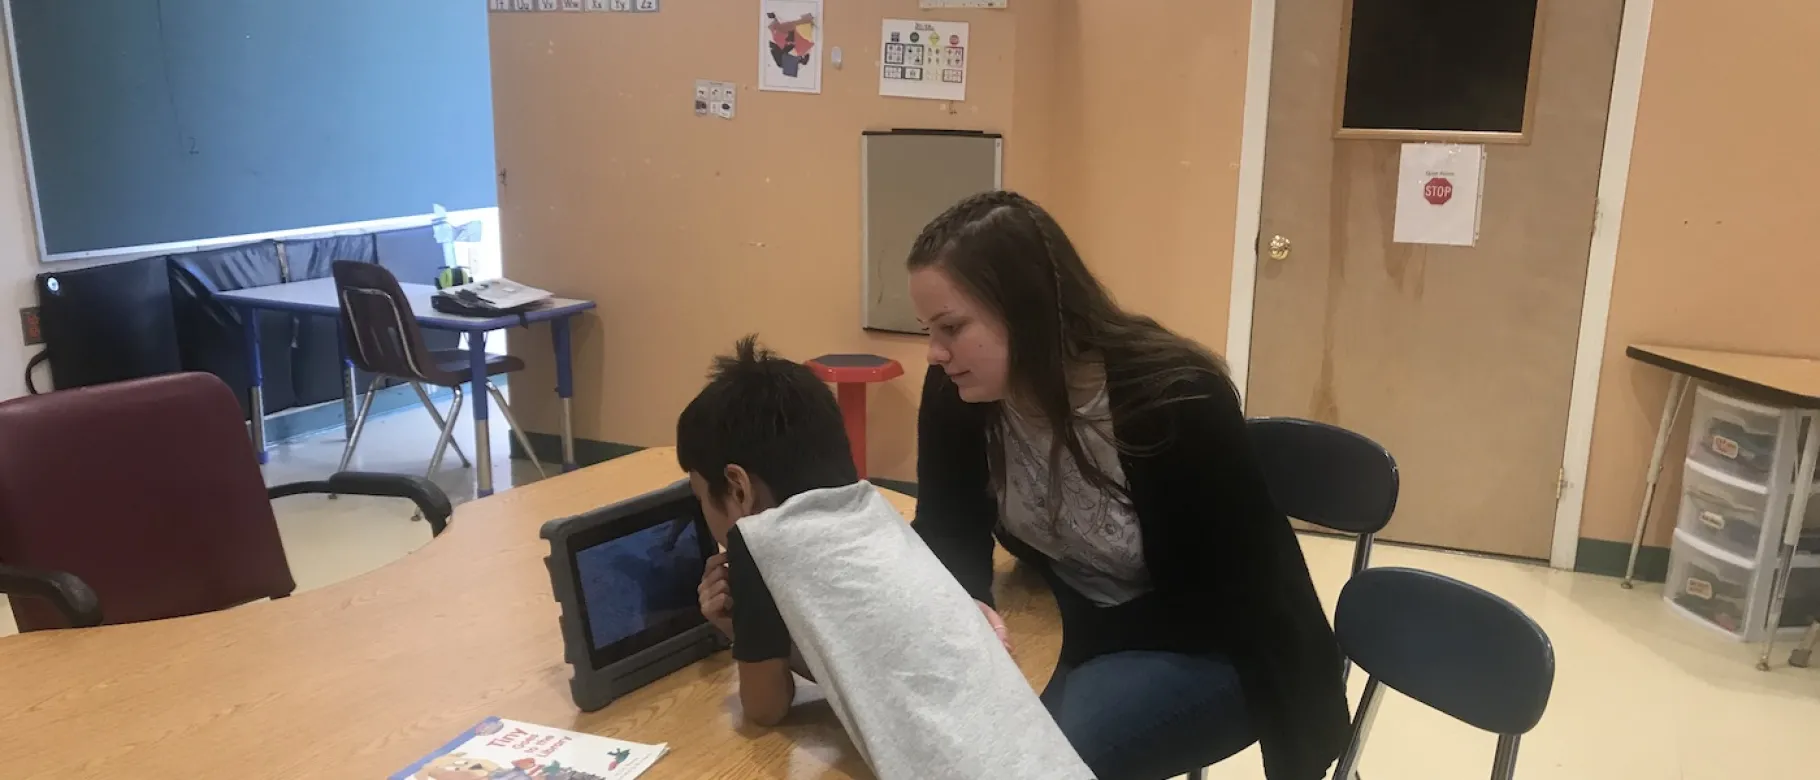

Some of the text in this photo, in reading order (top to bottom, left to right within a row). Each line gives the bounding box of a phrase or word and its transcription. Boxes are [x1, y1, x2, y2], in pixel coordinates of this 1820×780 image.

[1425, 185, 1452, 197] STOP
[486, 727, 528, 747] Tiny
[535, 735, 573, 757] Library
